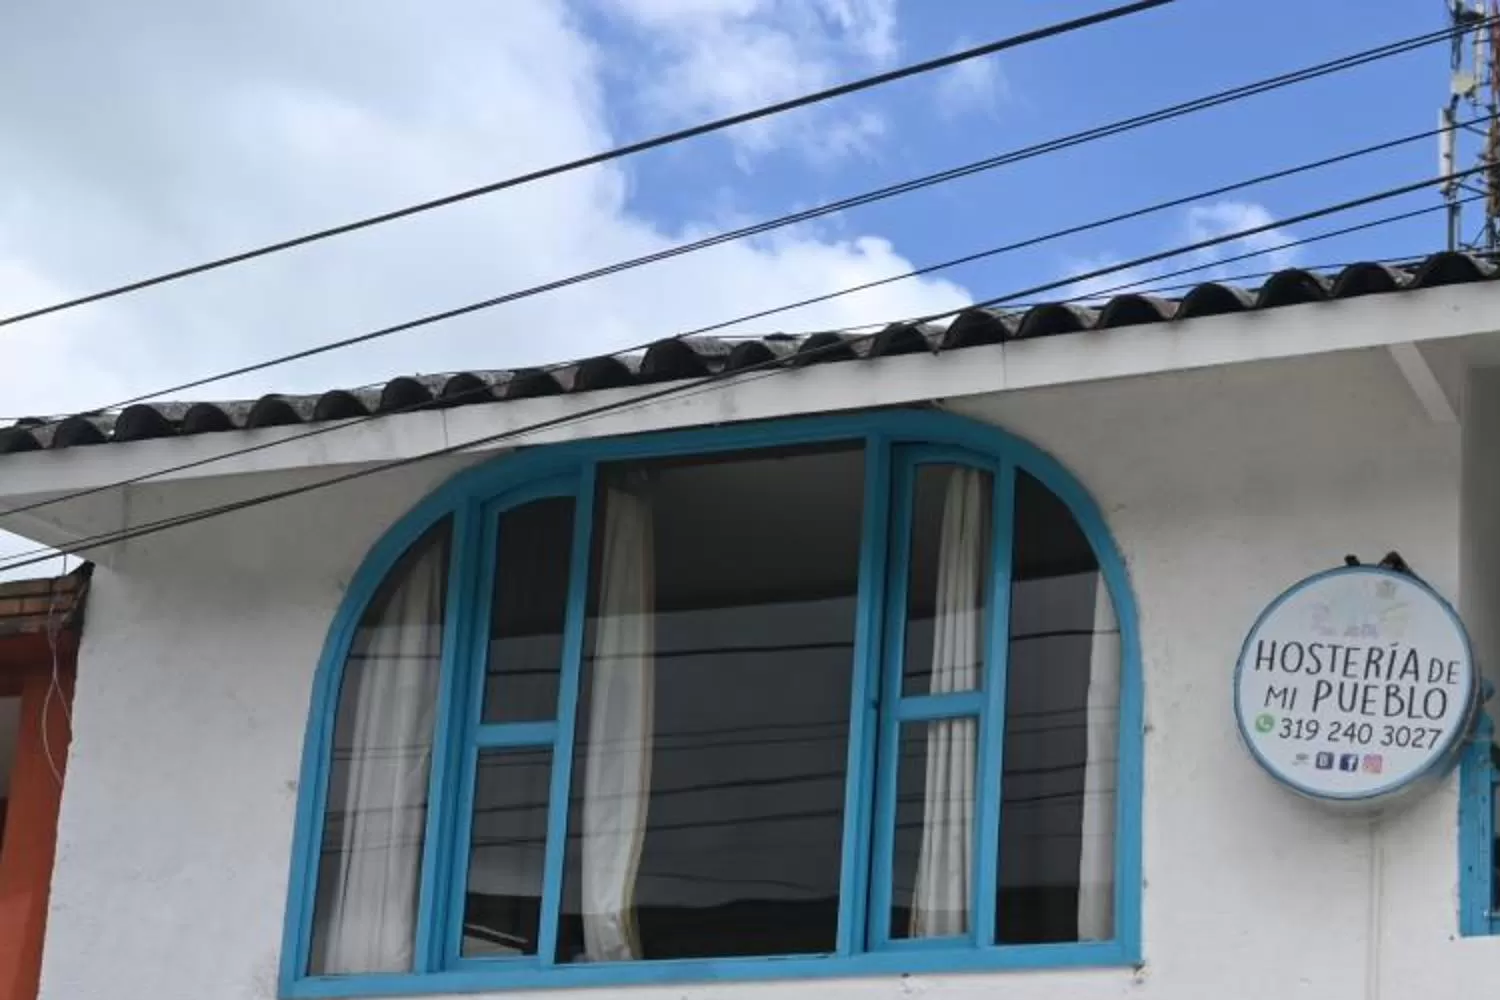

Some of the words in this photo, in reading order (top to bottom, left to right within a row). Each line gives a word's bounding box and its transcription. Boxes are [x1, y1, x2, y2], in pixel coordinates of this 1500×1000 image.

[1255, 639, 1419, 681] HOSTERÍA
[1427, 657, 1461, 684] DE
[1263, 685, 1297, 710] MI
[1312, 679, 1447, 720] PUEBLO
[1279, 717, 1320, 741] 319
[1327, 721, 1373, 745] 240
[1380, 726, 1443, 750] 3027
